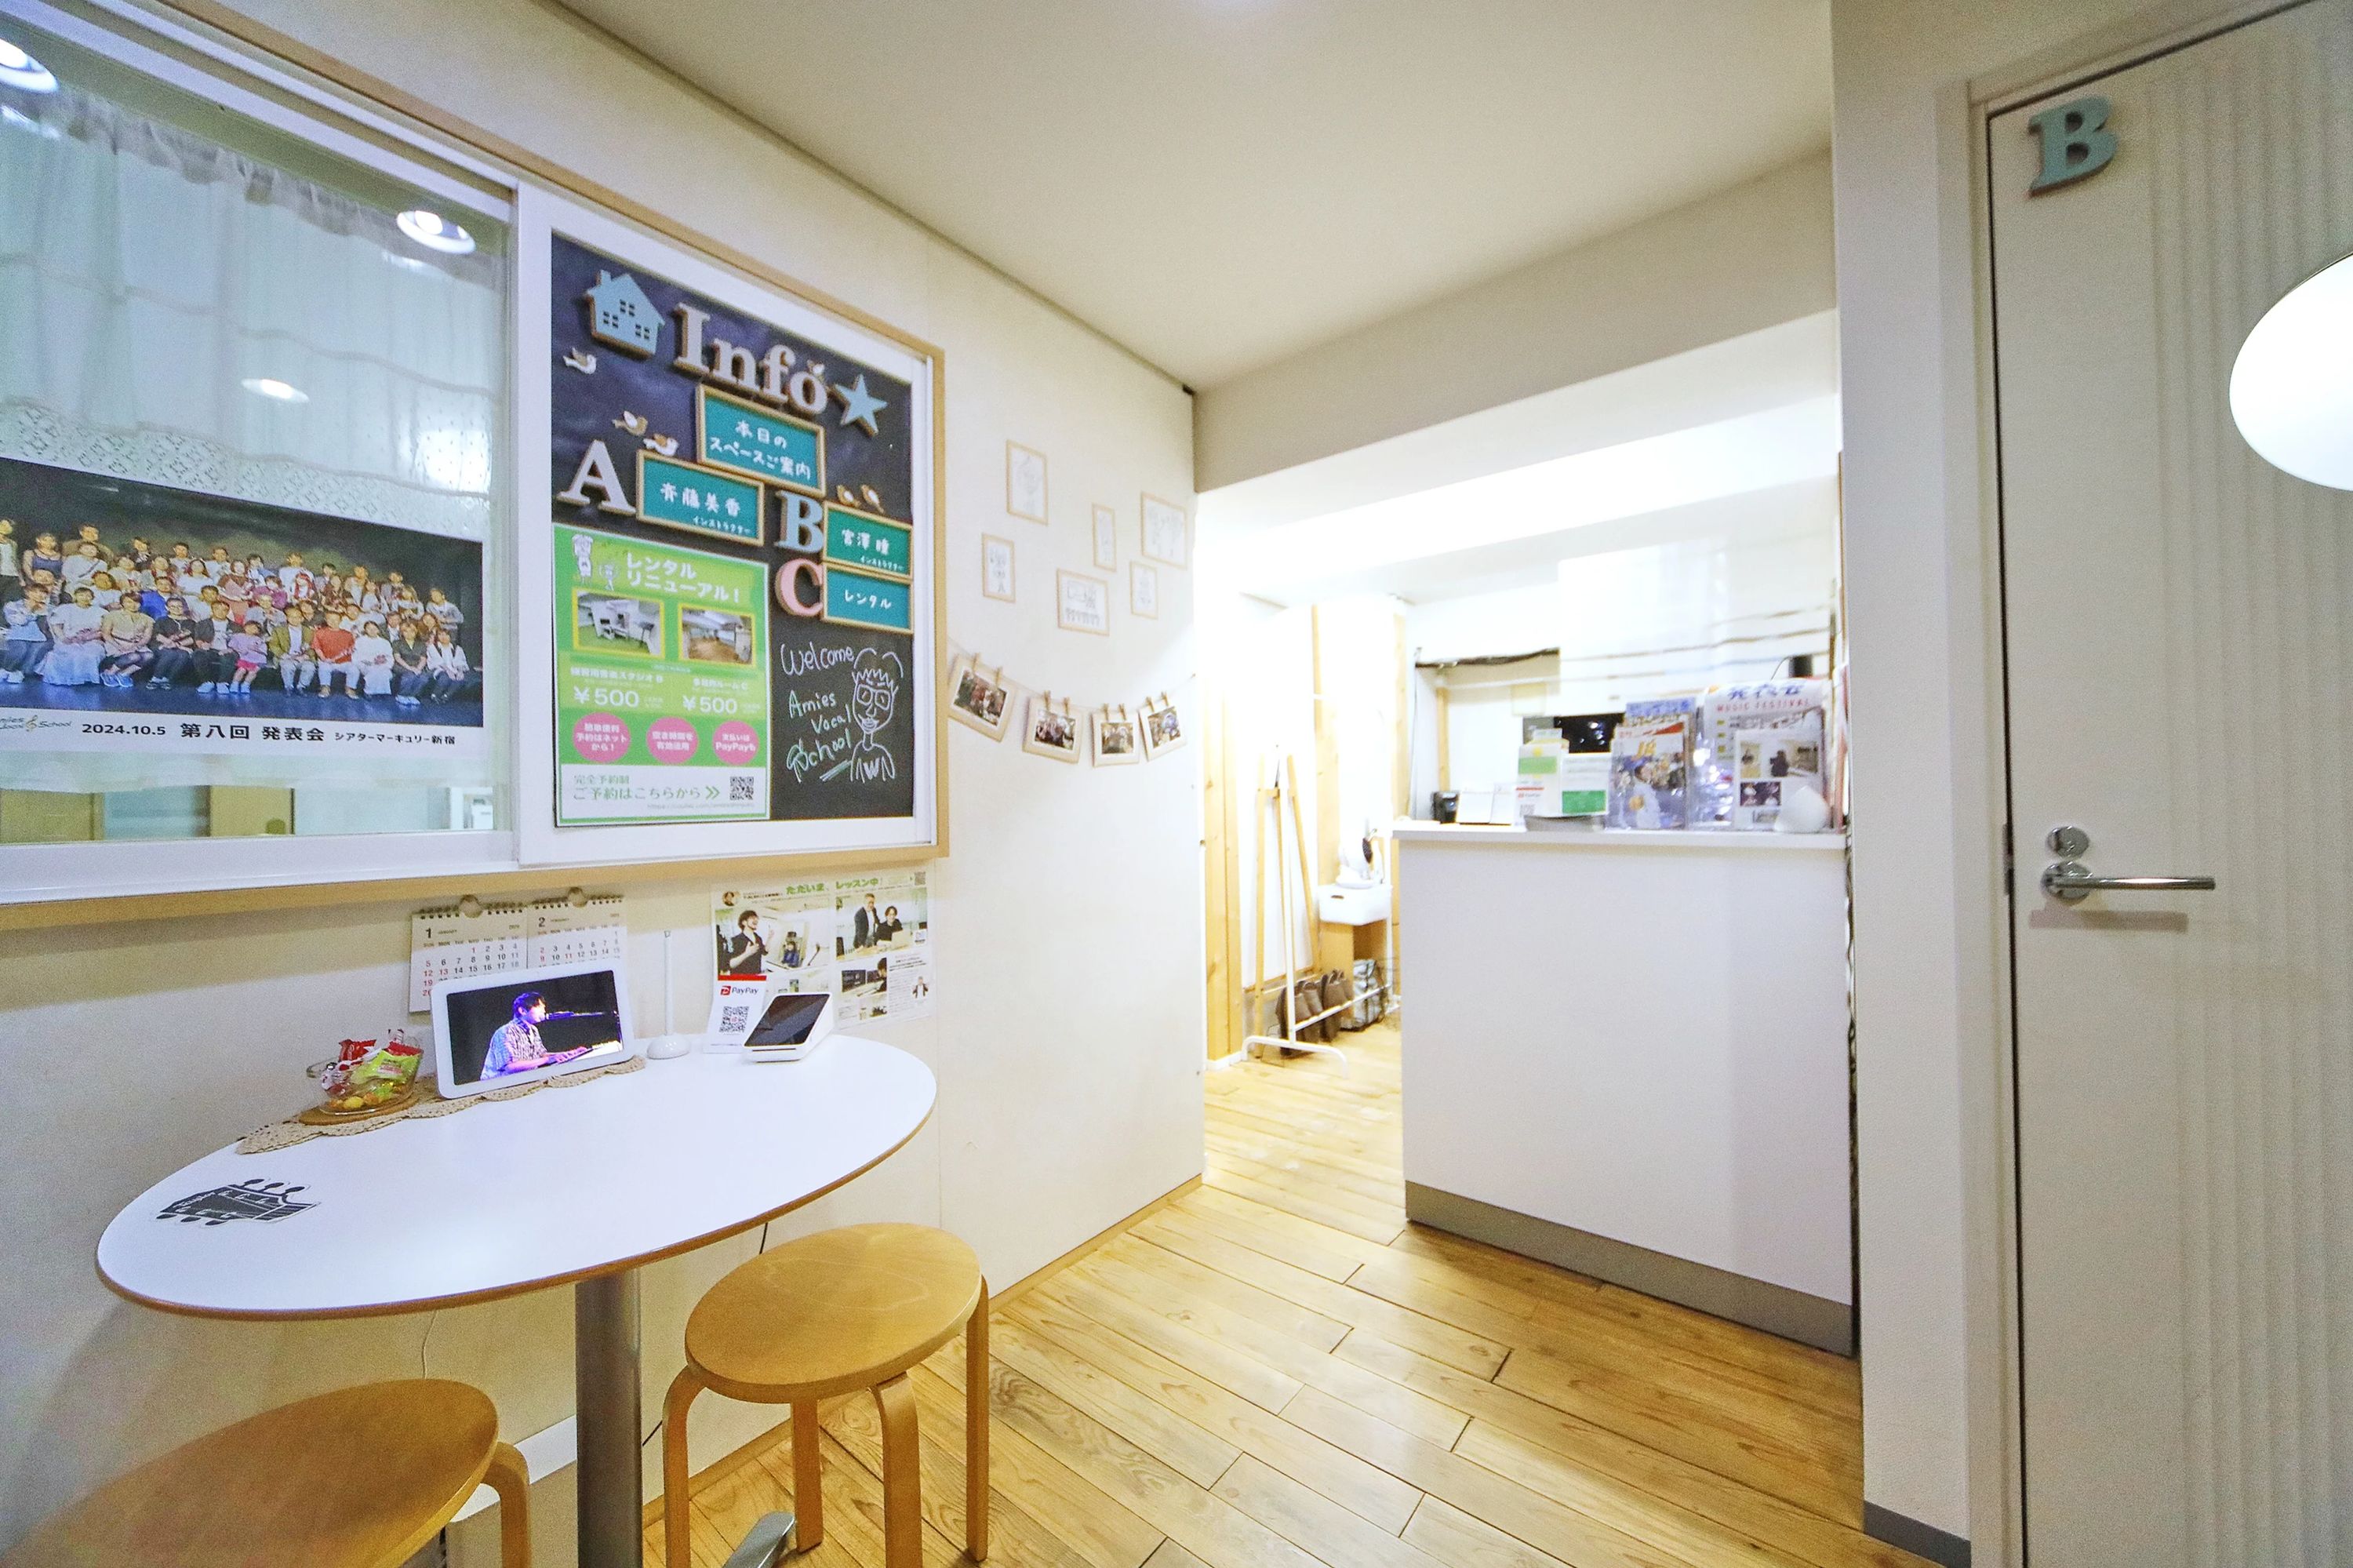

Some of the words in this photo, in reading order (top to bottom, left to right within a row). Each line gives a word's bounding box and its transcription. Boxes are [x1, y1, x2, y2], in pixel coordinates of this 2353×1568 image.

[2028, 96, 2118, 198] B
[675, 302, 827, 414] Info
[735, 420, 787, 448] 本日の
[710, 436, 811, 480] スペースご案内
[556, 439, 637, 515] A
[774, 489, 824, 552] B
[627, 552, 696, 579] レンタル
[776, 558, 823, 617] C
[845, 589, 891, 609] レンタル
[781, 641, 854, 675] Welcome
[789, 689, 836, 718] Amies
[82, 723, 166, 735] 2024.10.5
[180, 723, 249, 739] 第八回
[262, 726, 325, 741] 発表会
[811, 704, 852, 734] Vocal
[426, 927, 431, 938] 1
[539, 917, 545, 927] 2
[732, 987, 758, 995] PayPay
